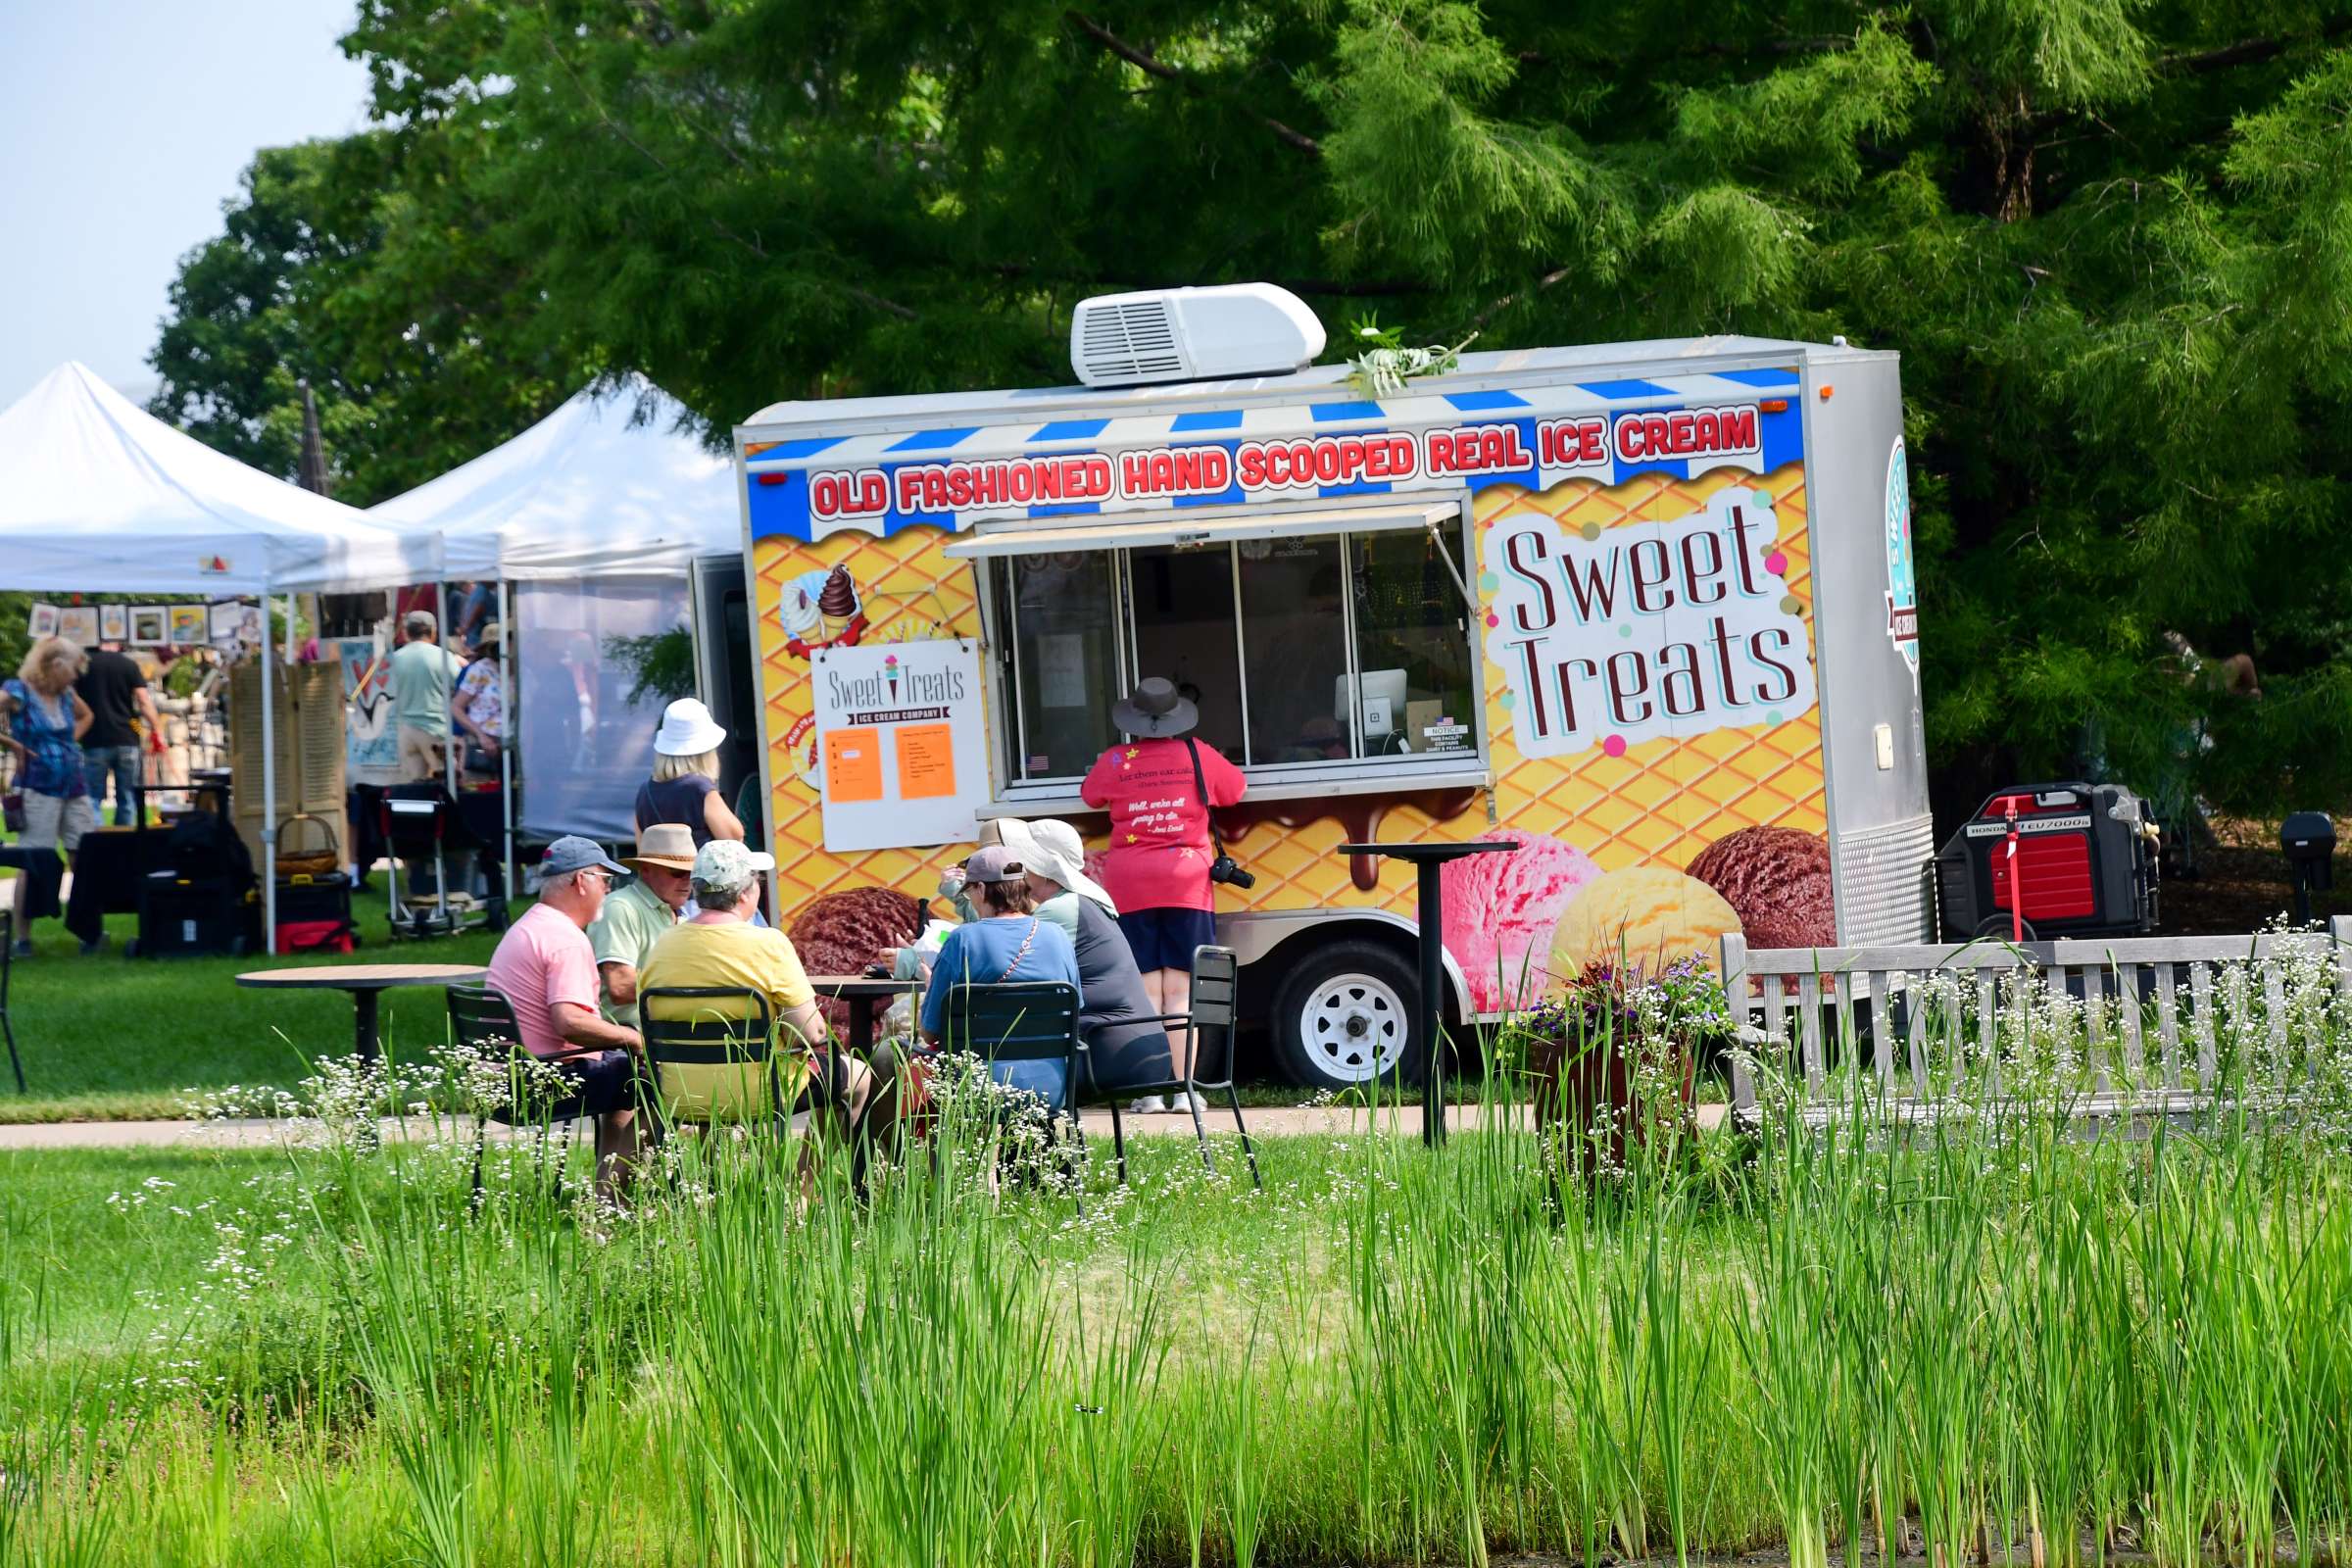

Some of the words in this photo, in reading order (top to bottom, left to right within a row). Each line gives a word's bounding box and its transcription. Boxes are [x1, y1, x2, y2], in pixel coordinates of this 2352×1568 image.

[812, 472, 888, 515] OLD
[898, 460, 1114, 510] FASHIONED
[1123, 445, 1229, 495] HAND
[1240, 439, 1415, 487] SCOOPED
[1428, 424, 1531, 473] REAL
[1542, 416, 1604, 466] ICE
[1619, 408, 1757, 460] CREAM
[1503, 505, 1768, 633] Sweet
[1507, 616, 1797, 739] Treats
[828, 669, 884, 710] Sweet
[903, 664, 964, 704] Treats
[858, 714, 872, 723] ICE
[873, 711, 901, 722] CREAM
[902, 709, 939, 720] COMPANY
[1134, 769, 1157, 780] them
[1172, 797, 1185, 807] all
[1131, 815, 1154, 827] going
[1155, 812, 1165, 821] to
[1971, 825, 2007, 835] HONDA
